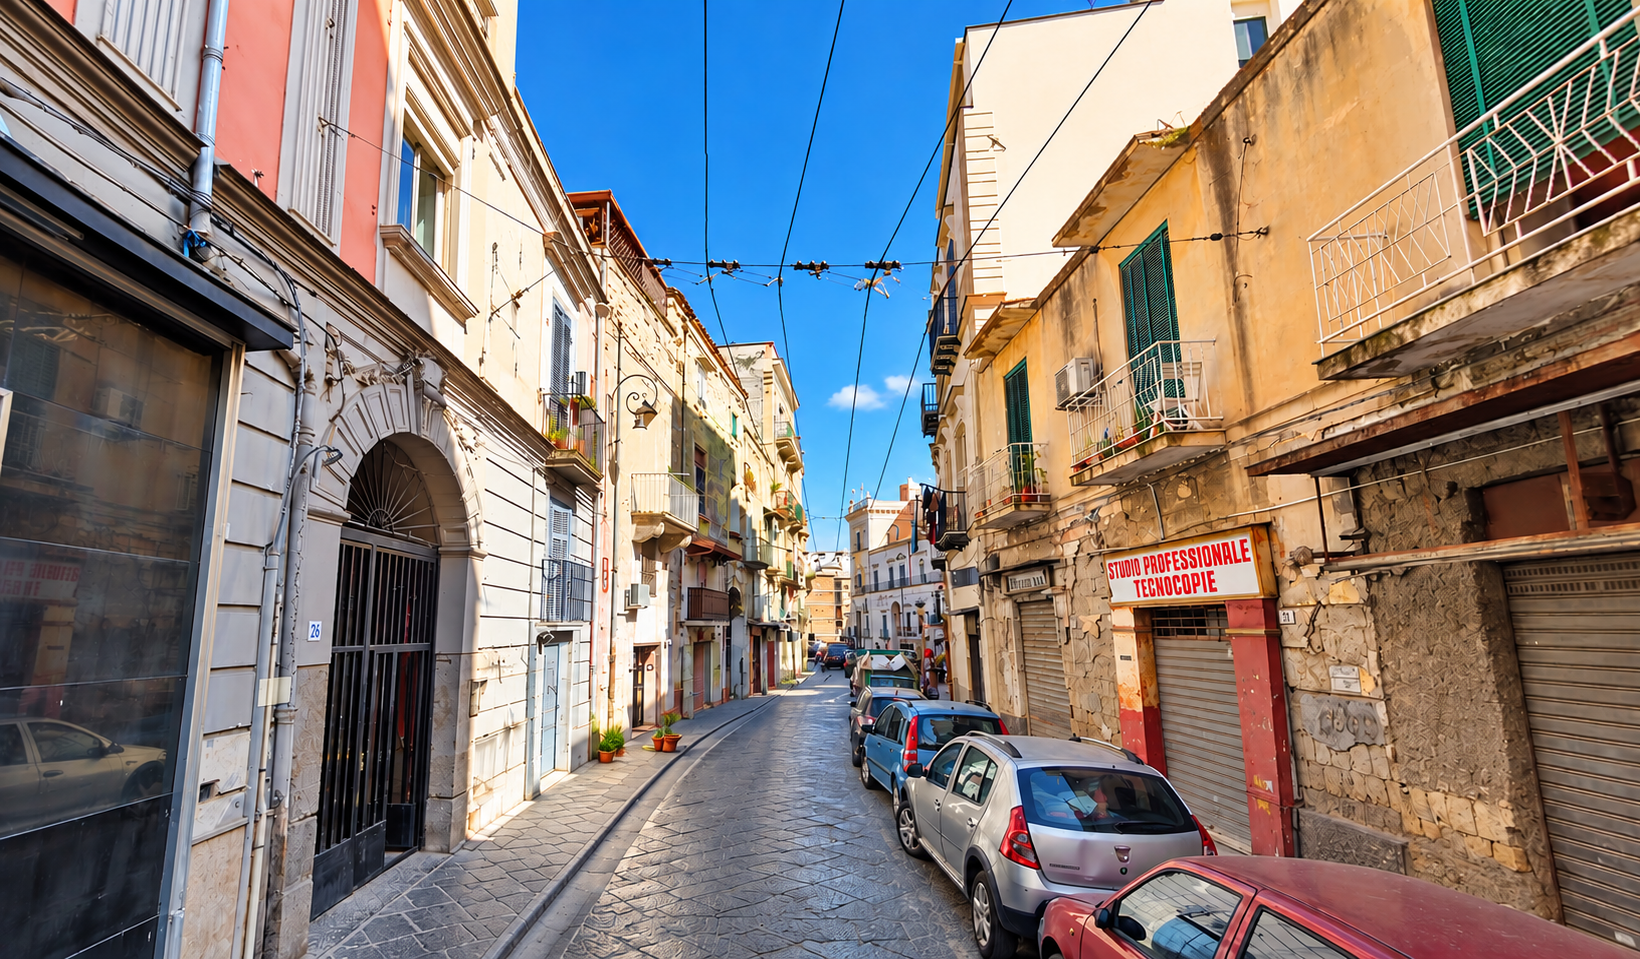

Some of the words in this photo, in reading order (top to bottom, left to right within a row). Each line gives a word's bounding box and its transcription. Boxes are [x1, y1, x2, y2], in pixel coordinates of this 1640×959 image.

[1107, 557, 1142, 580] STUDIO
[1143, 538, 1252, 575] PROFESSIONALE
[1133, 570, 1218, 598] TECNOCOPIE
[310, 623, 320, 638] 26
